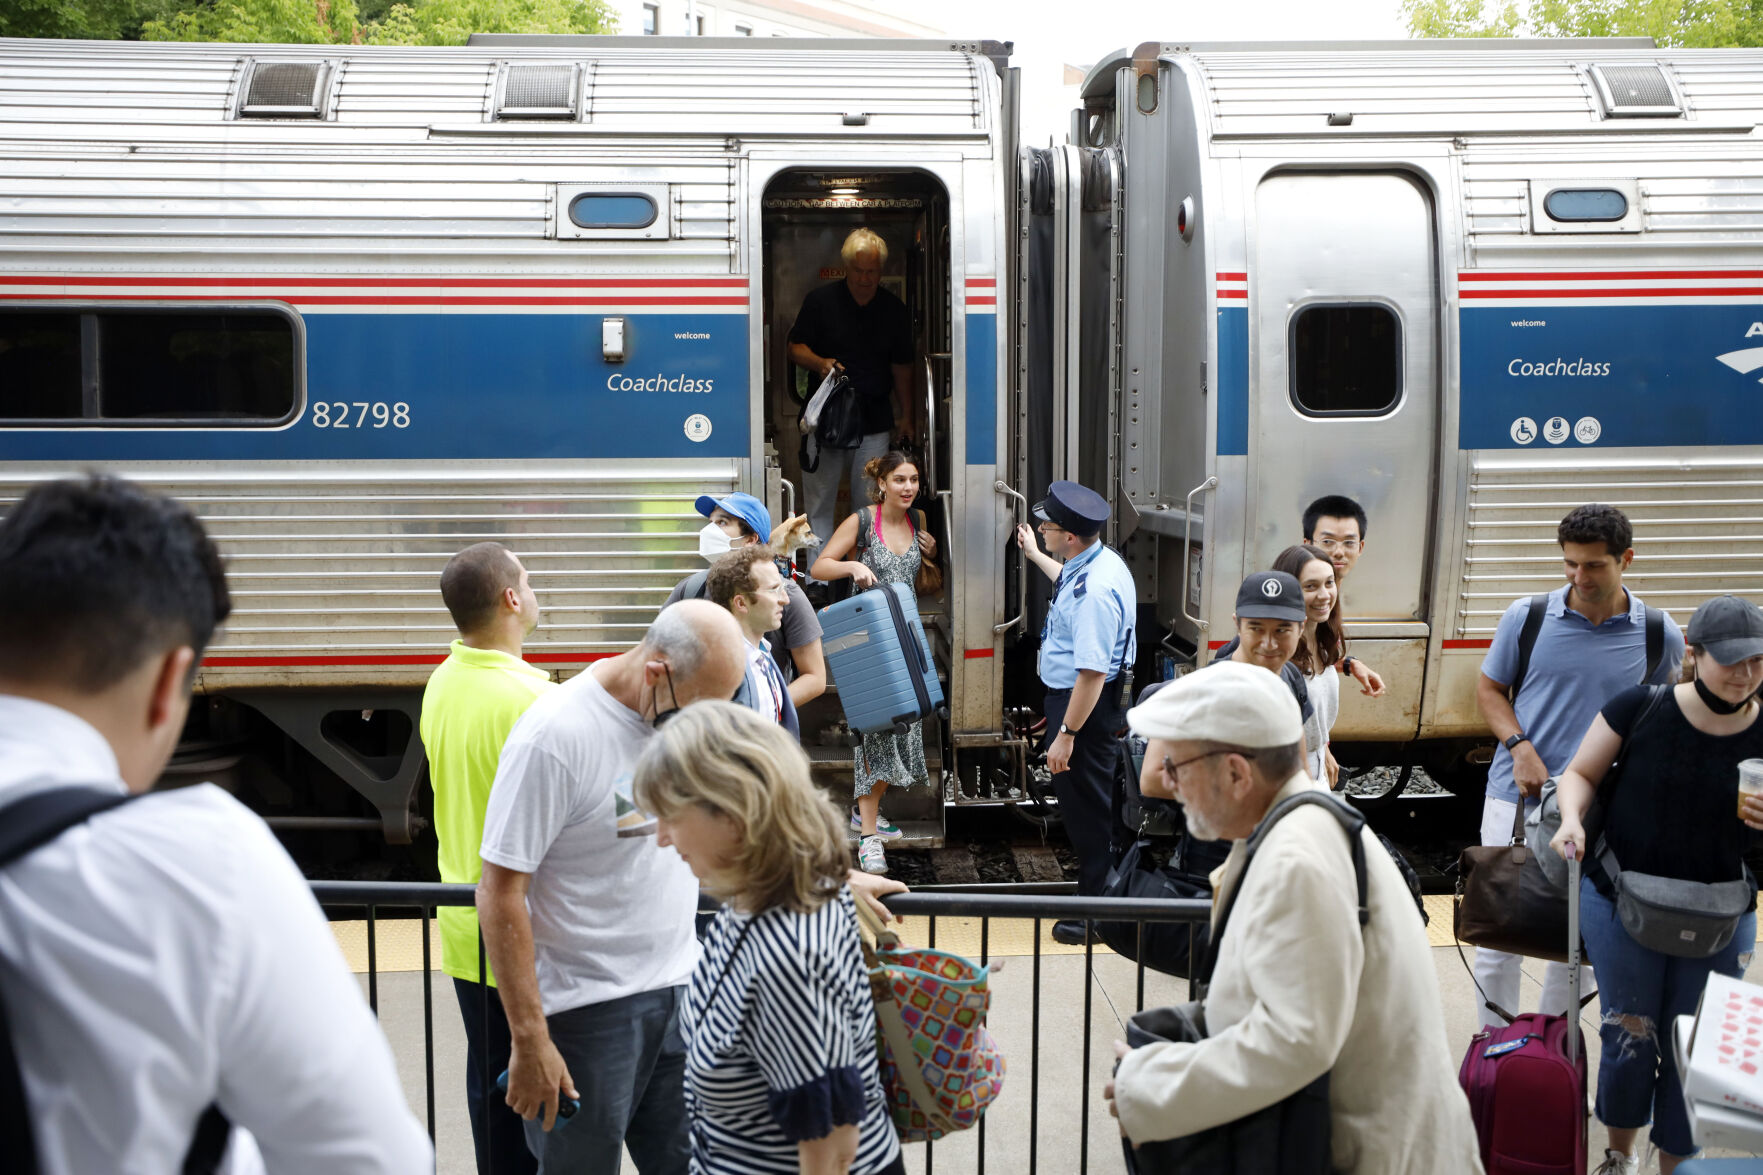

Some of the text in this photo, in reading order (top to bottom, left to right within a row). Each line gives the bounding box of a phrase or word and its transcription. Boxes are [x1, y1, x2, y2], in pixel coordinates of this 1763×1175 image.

[1510, 318, 1546, 328] welcome
[674, 331, 711, 340] welcome
[1508, 357, 1611, 377] Coachclass
[607, 373, 714, 393] Coachclass
[312, 401, 411, 429] 82798
